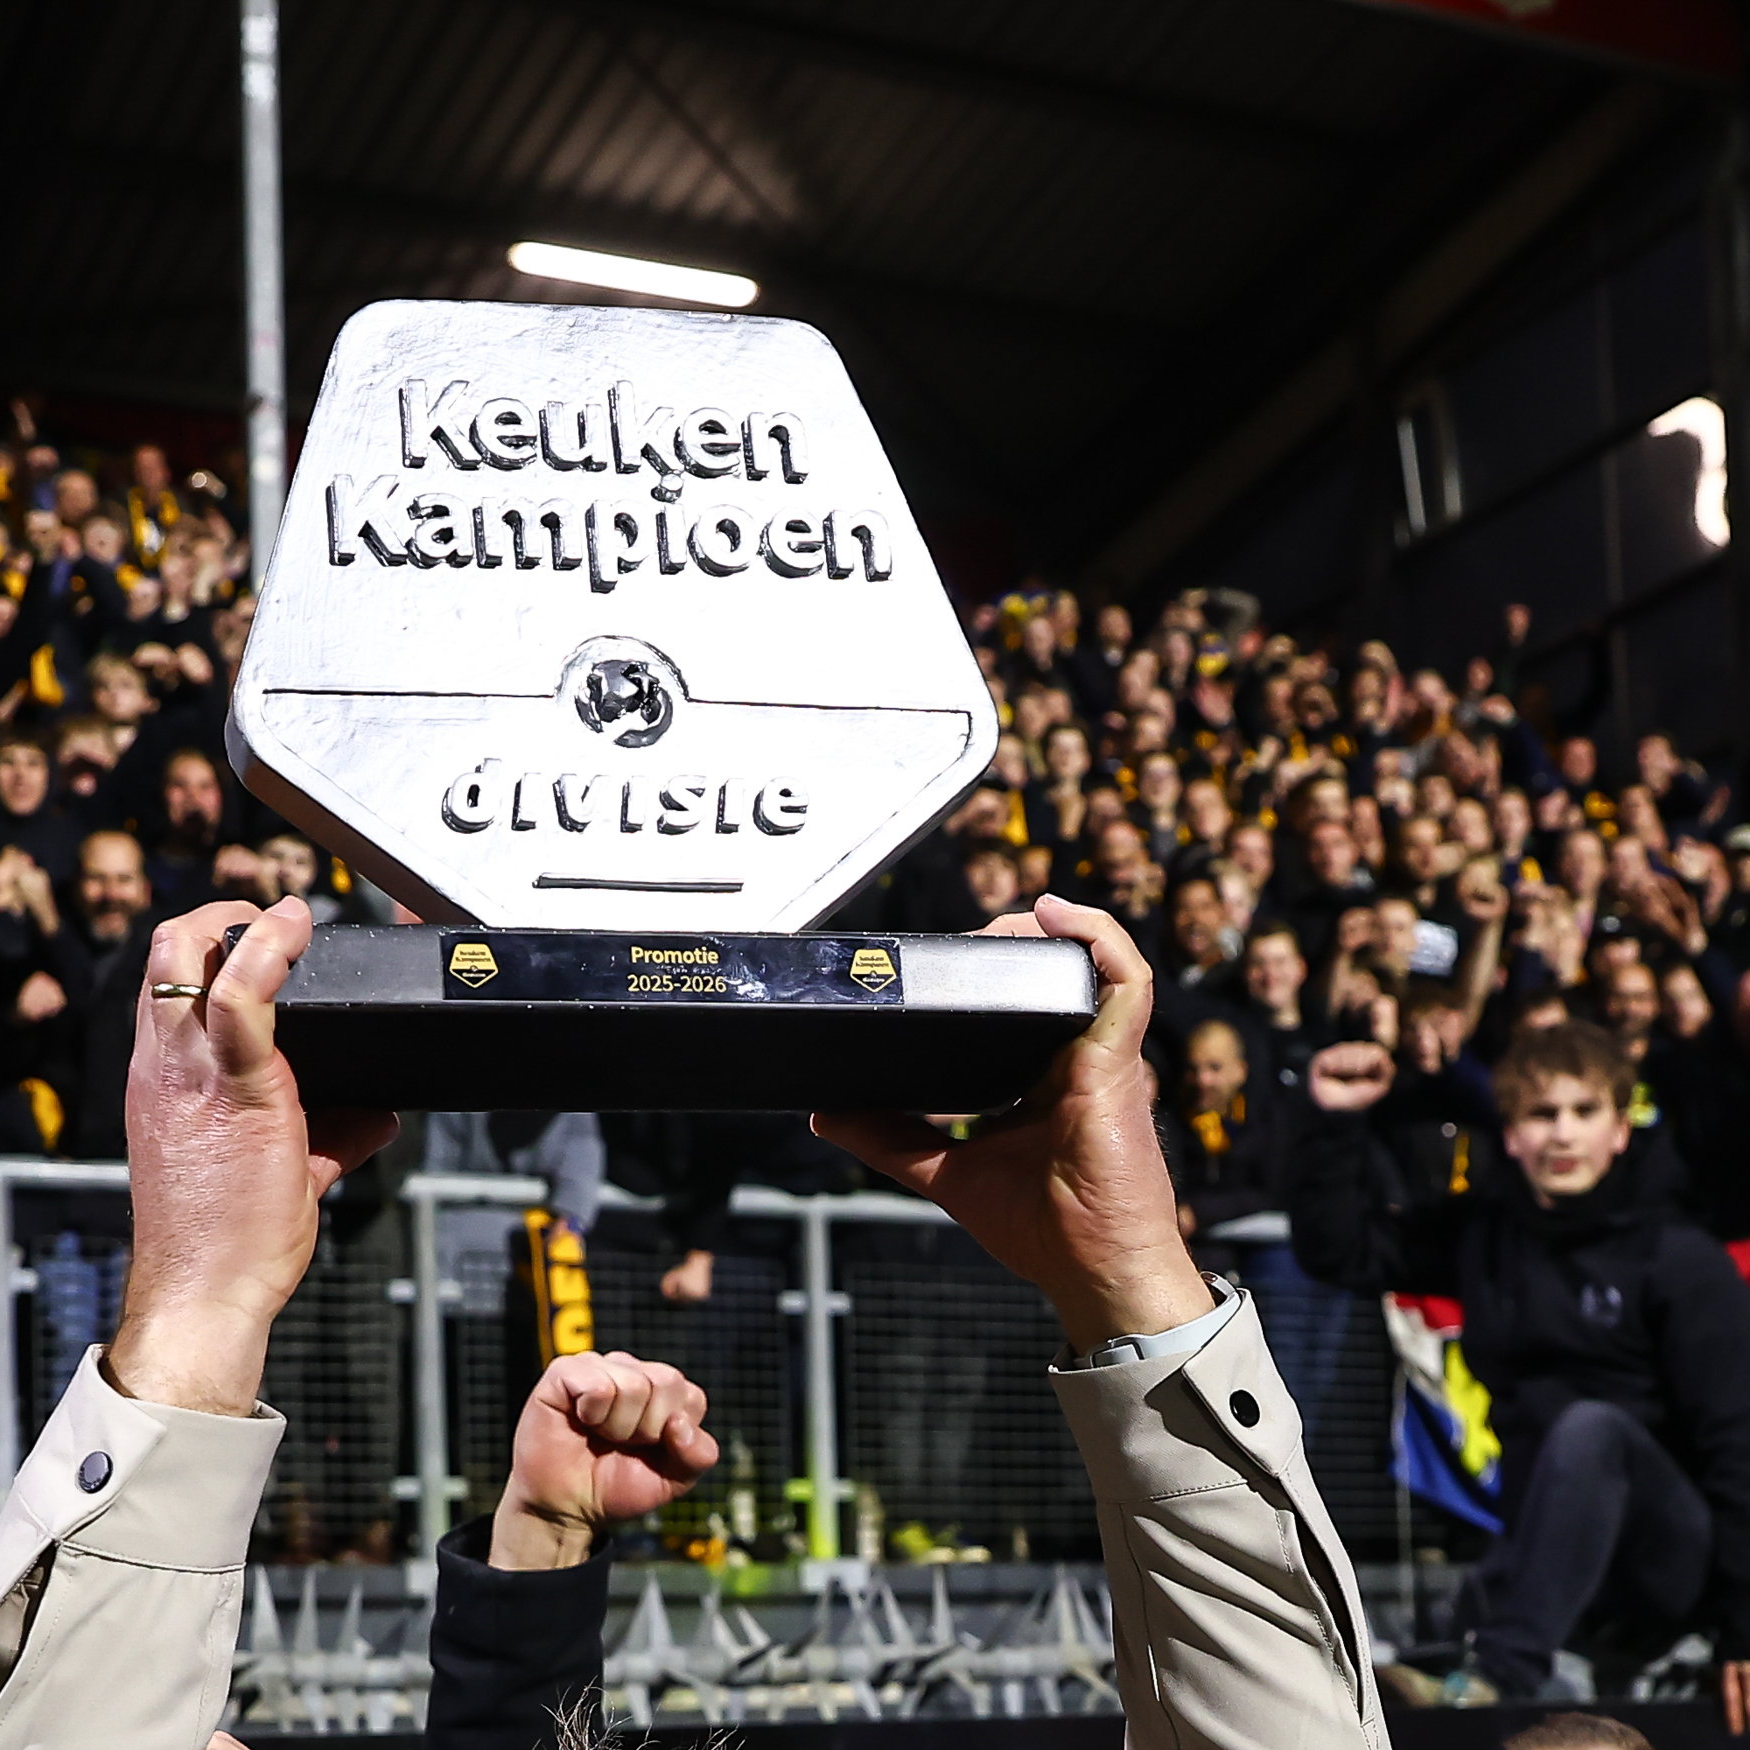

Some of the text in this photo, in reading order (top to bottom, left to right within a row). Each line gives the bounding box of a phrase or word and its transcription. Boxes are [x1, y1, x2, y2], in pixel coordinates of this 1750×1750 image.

[398, 379, 809, 484] Keuken
[325, 472, 893, 594] Kampioen
[441, 757, 810, 836] divisie
[627, 974, 727, 993] 2025-2026
[630, 946, 719, 964] Promotie
